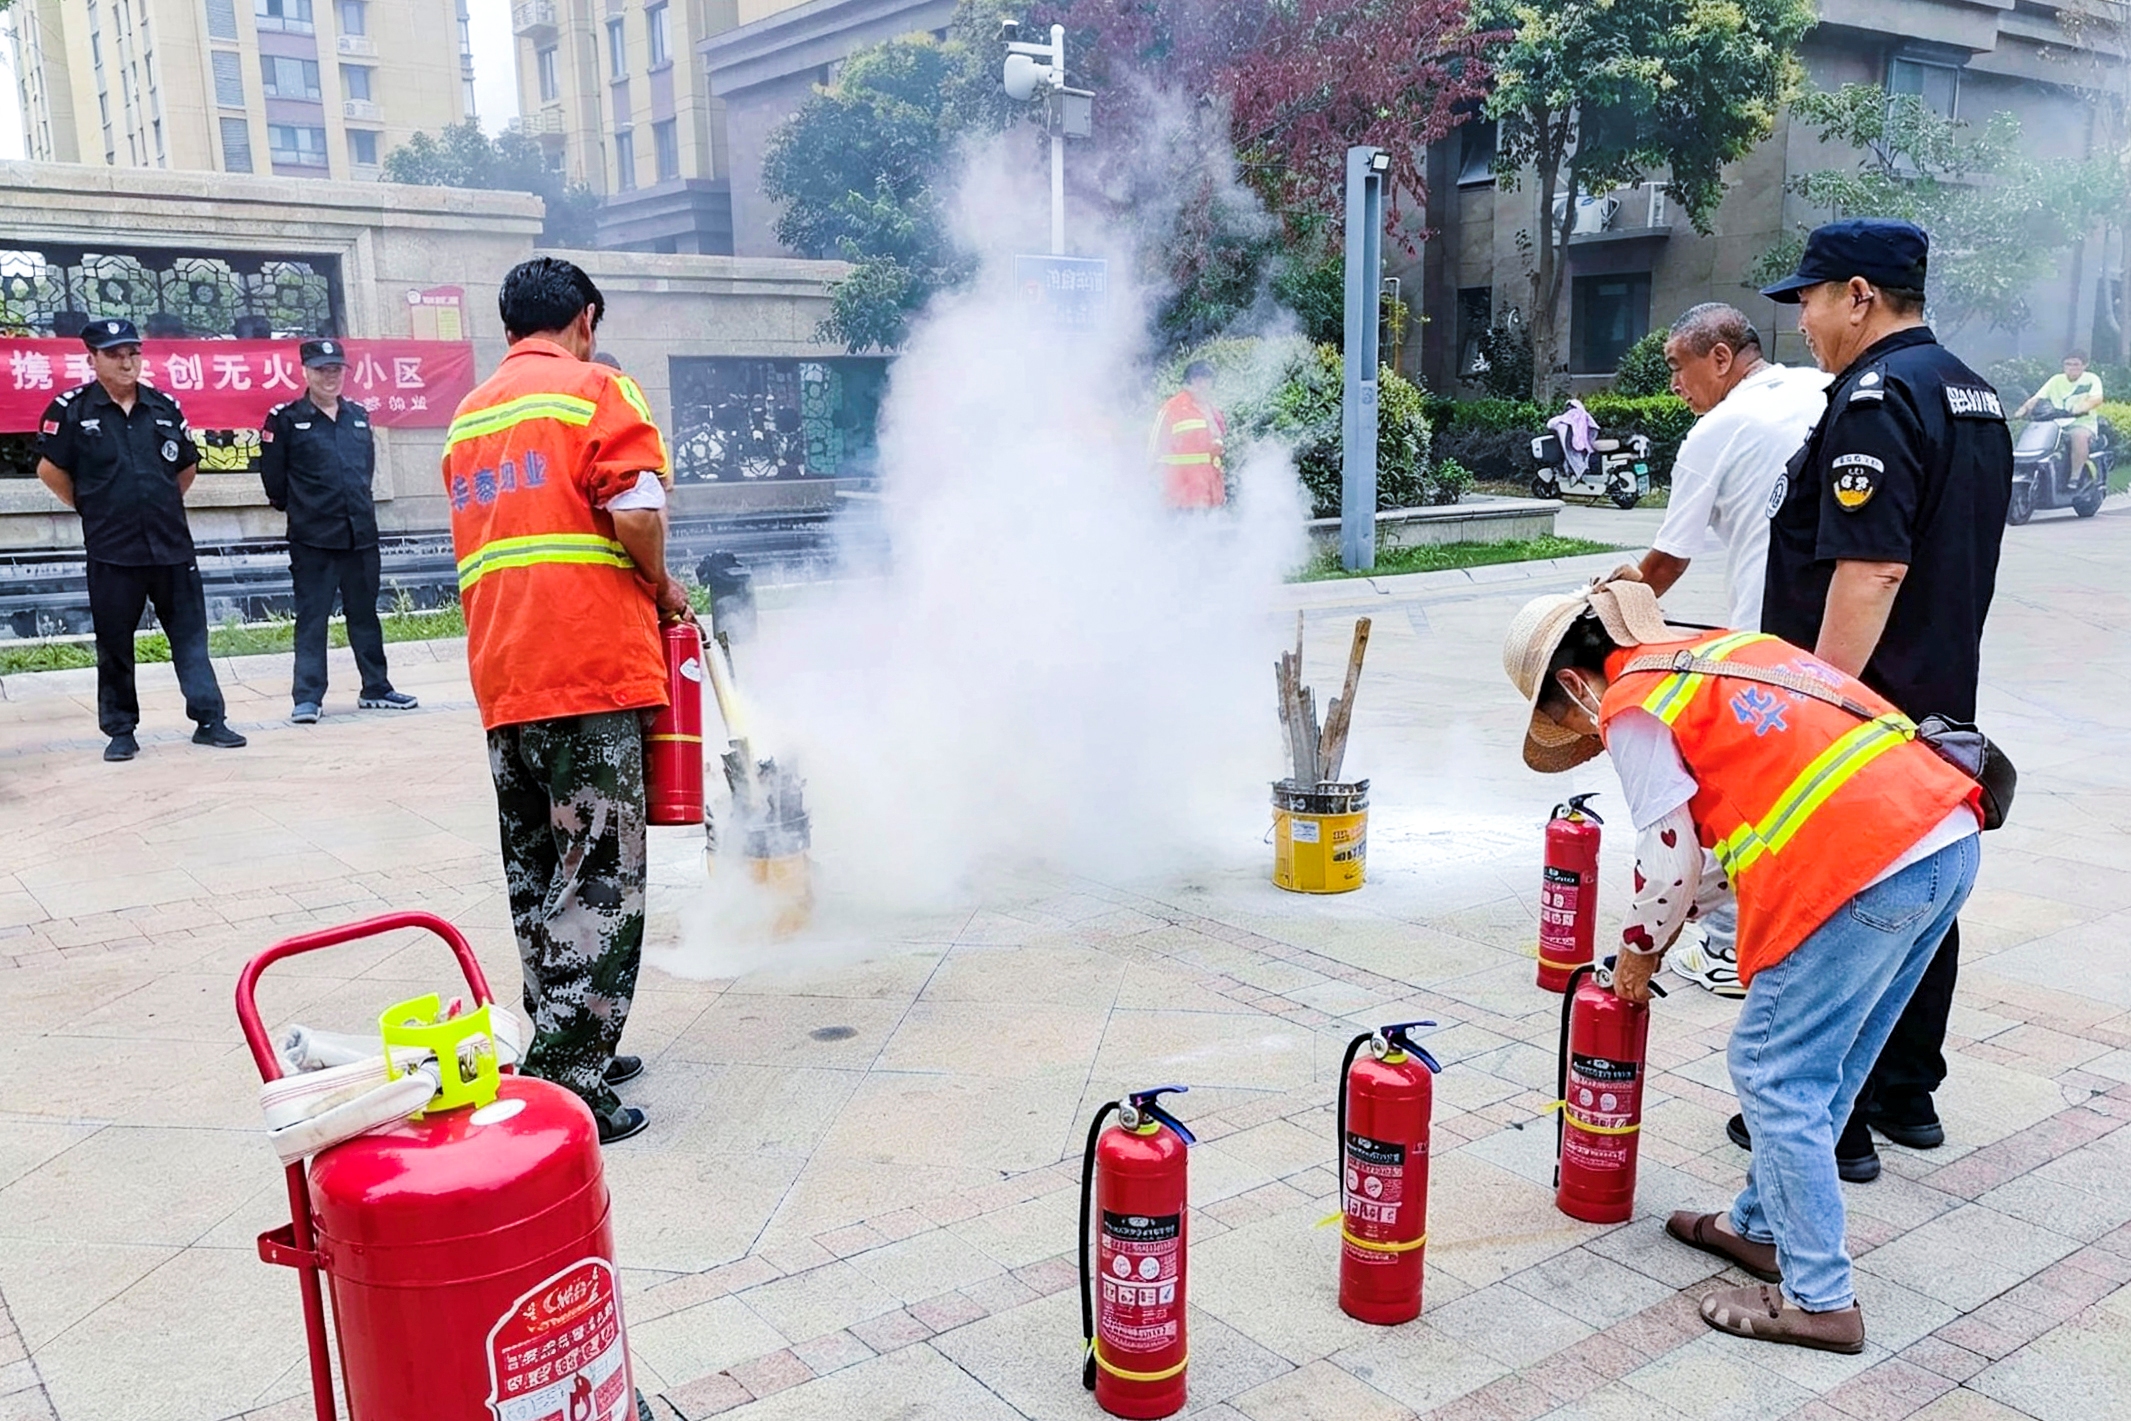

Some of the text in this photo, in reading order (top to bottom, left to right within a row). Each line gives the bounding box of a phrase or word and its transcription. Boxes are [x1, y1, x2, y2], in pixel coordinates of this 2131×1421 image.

[9, 350, 426, 390] 携手创无火小区
